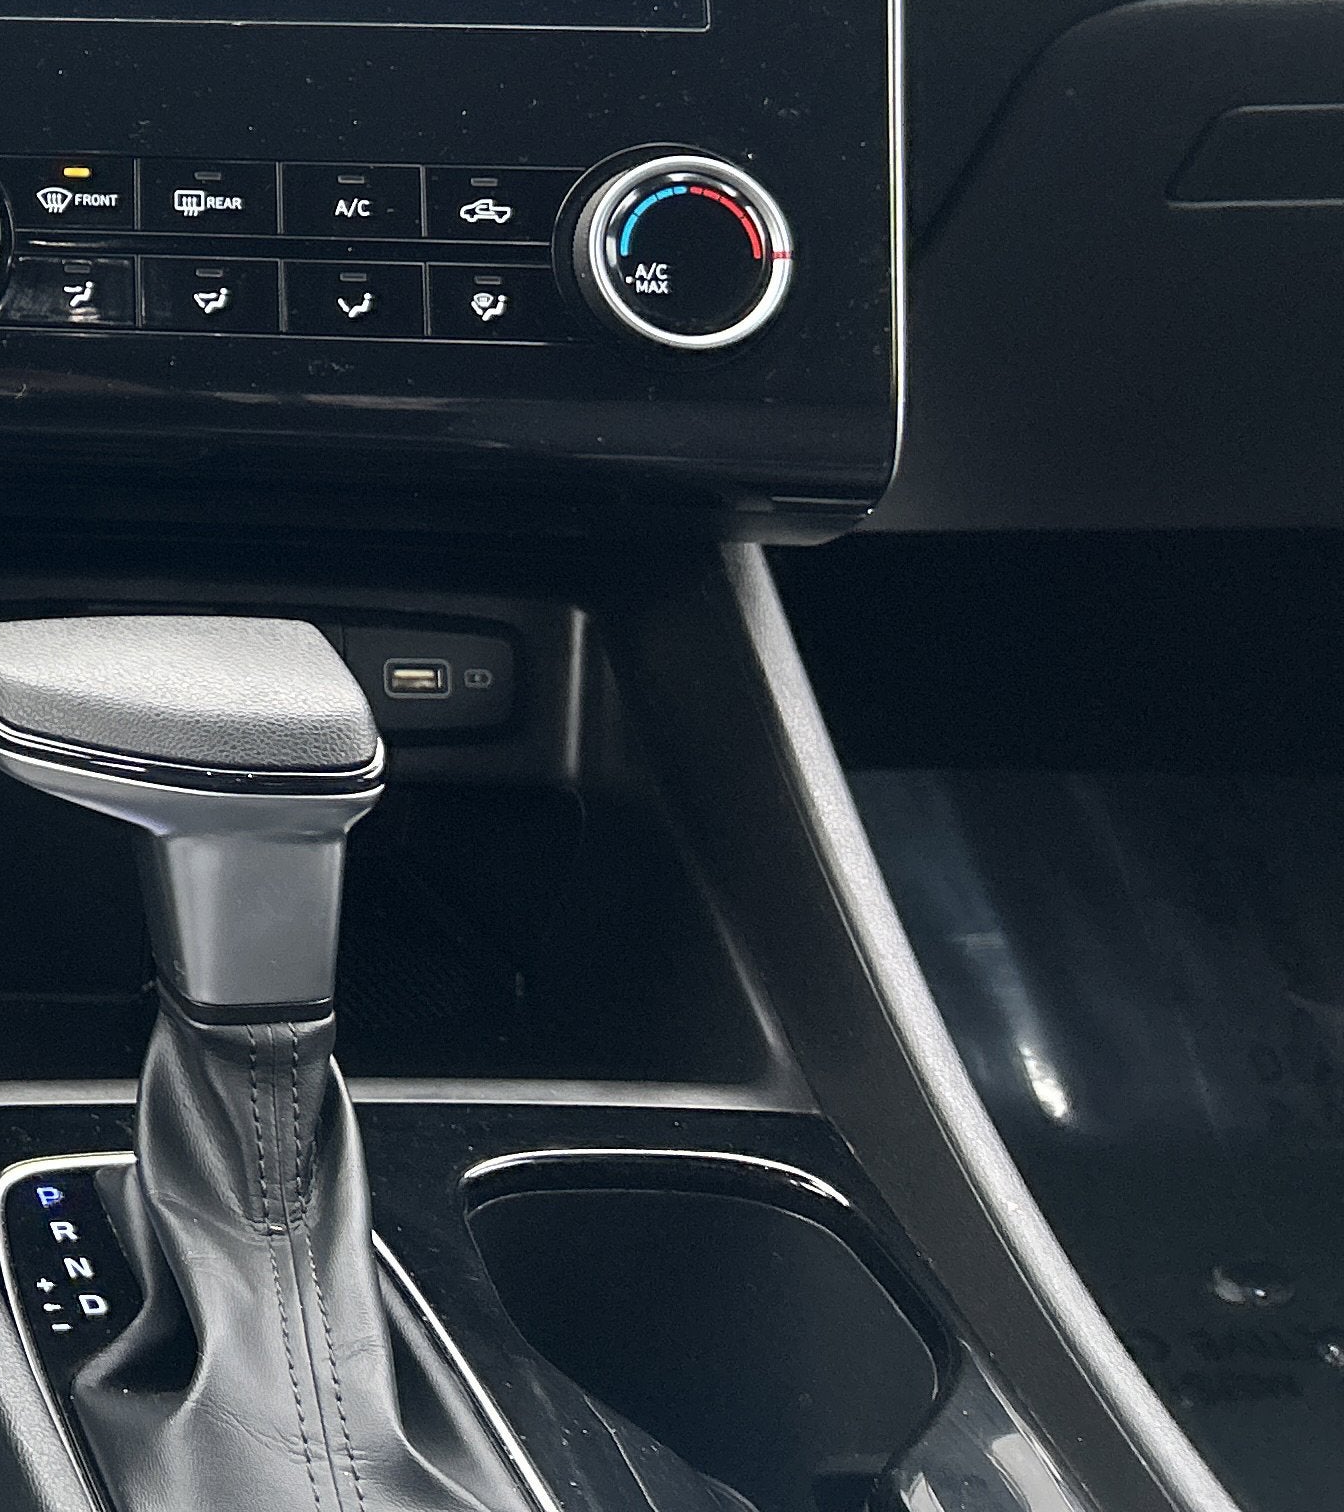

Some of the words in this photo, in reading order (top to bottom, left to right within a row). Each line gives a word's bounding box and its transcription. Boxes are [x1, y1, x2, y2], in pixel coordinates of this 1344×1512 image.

[74, 193, 119, 208] FRONT
[206, 196, 243, 210] REAR
[334, 198, 371, 218] A/C
[634, 263, 669, 281] A/C
[634, 280, 670, 295] MAX
[36, 1186, 63, 1209] P
[49, 1221, 79, 1243] R
[63, 1257, 95, 1280] N
[79, 1294, 110, 1317] D
